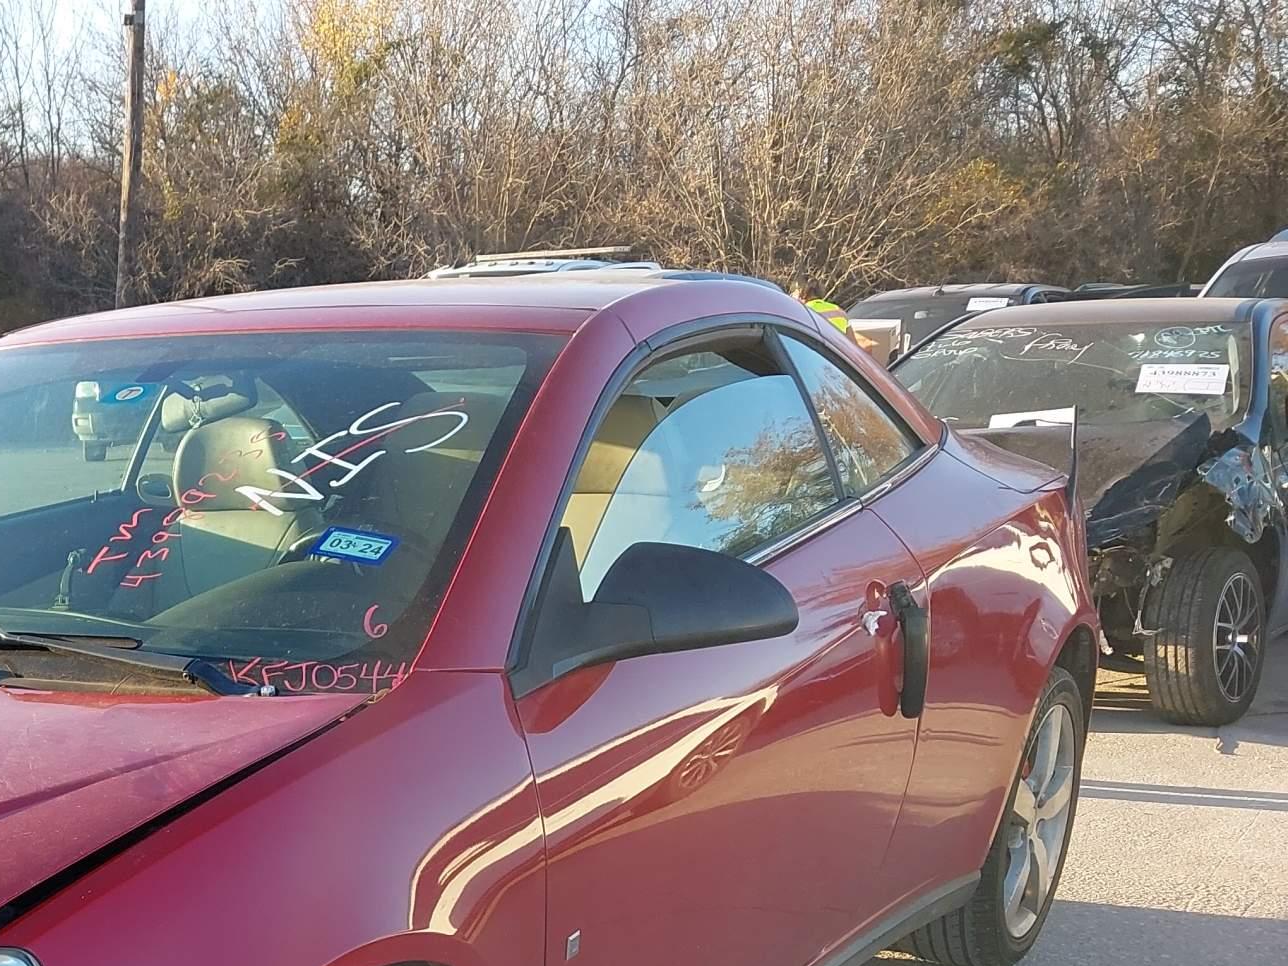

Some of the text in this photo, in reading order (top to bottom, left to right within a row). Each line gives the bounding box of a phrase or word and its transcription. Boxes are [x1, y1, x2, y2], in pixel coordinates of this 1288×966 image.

[329, 538, 353, 550] 03
[358, 543, 384, 556] 24
[363, 604, 388, 638] 6
